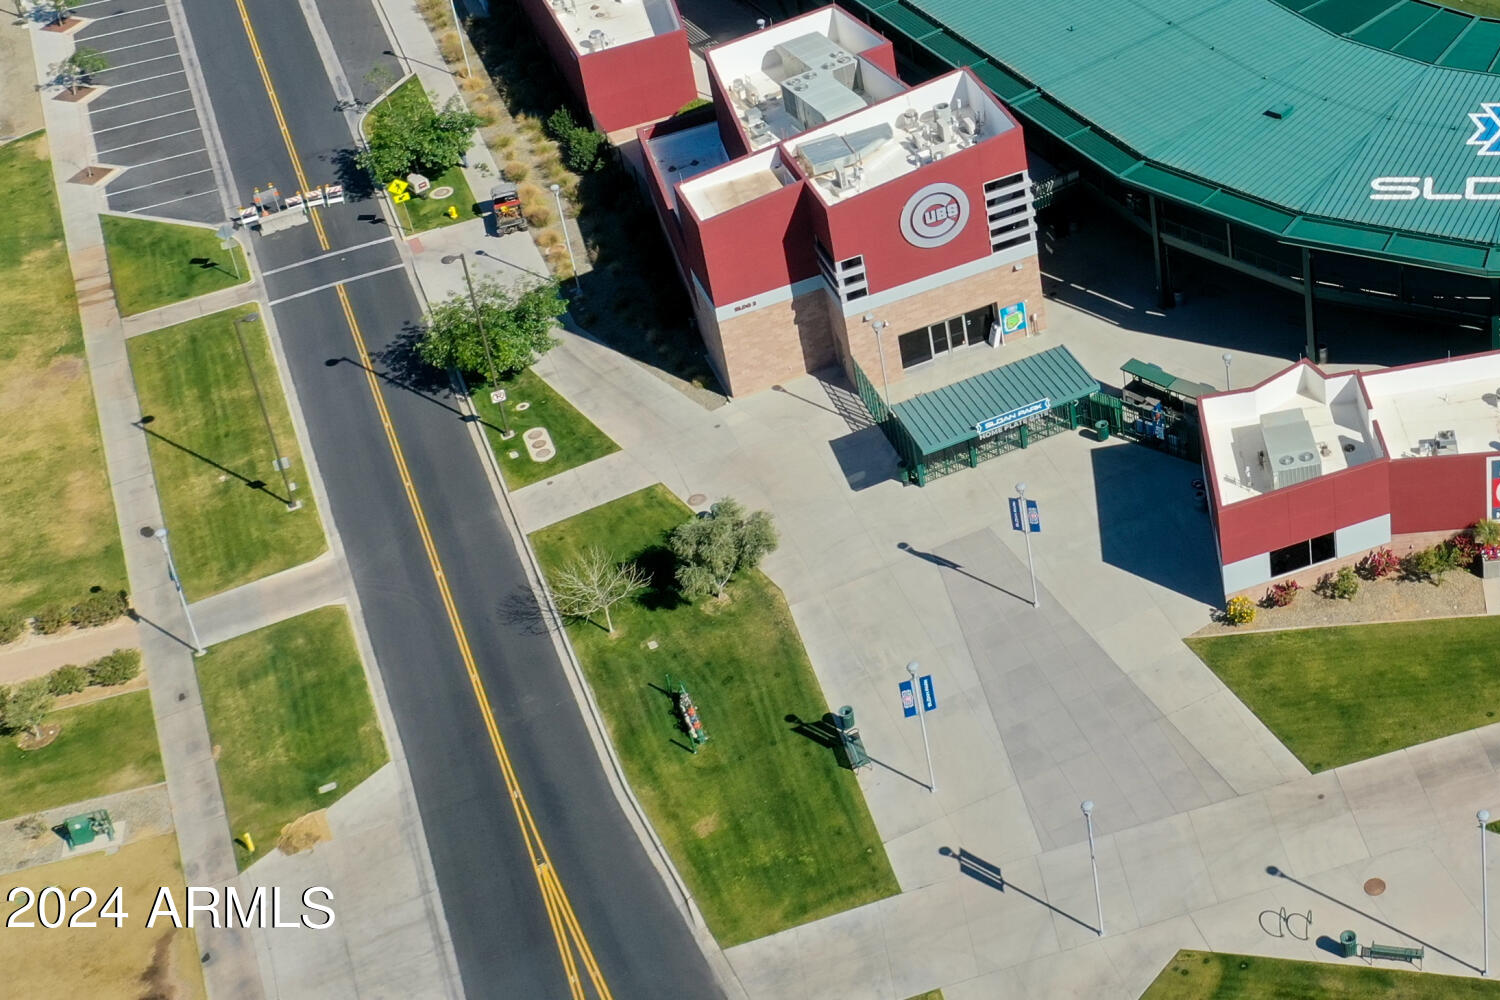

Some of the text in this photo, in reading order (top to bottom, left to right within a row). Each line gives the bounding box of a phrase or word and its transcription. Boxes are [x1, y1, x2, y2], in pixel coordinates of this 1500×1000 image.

[984, 403, 1043, 429] SLOAN PARK
[979, 427, 1003, 440] HOME
